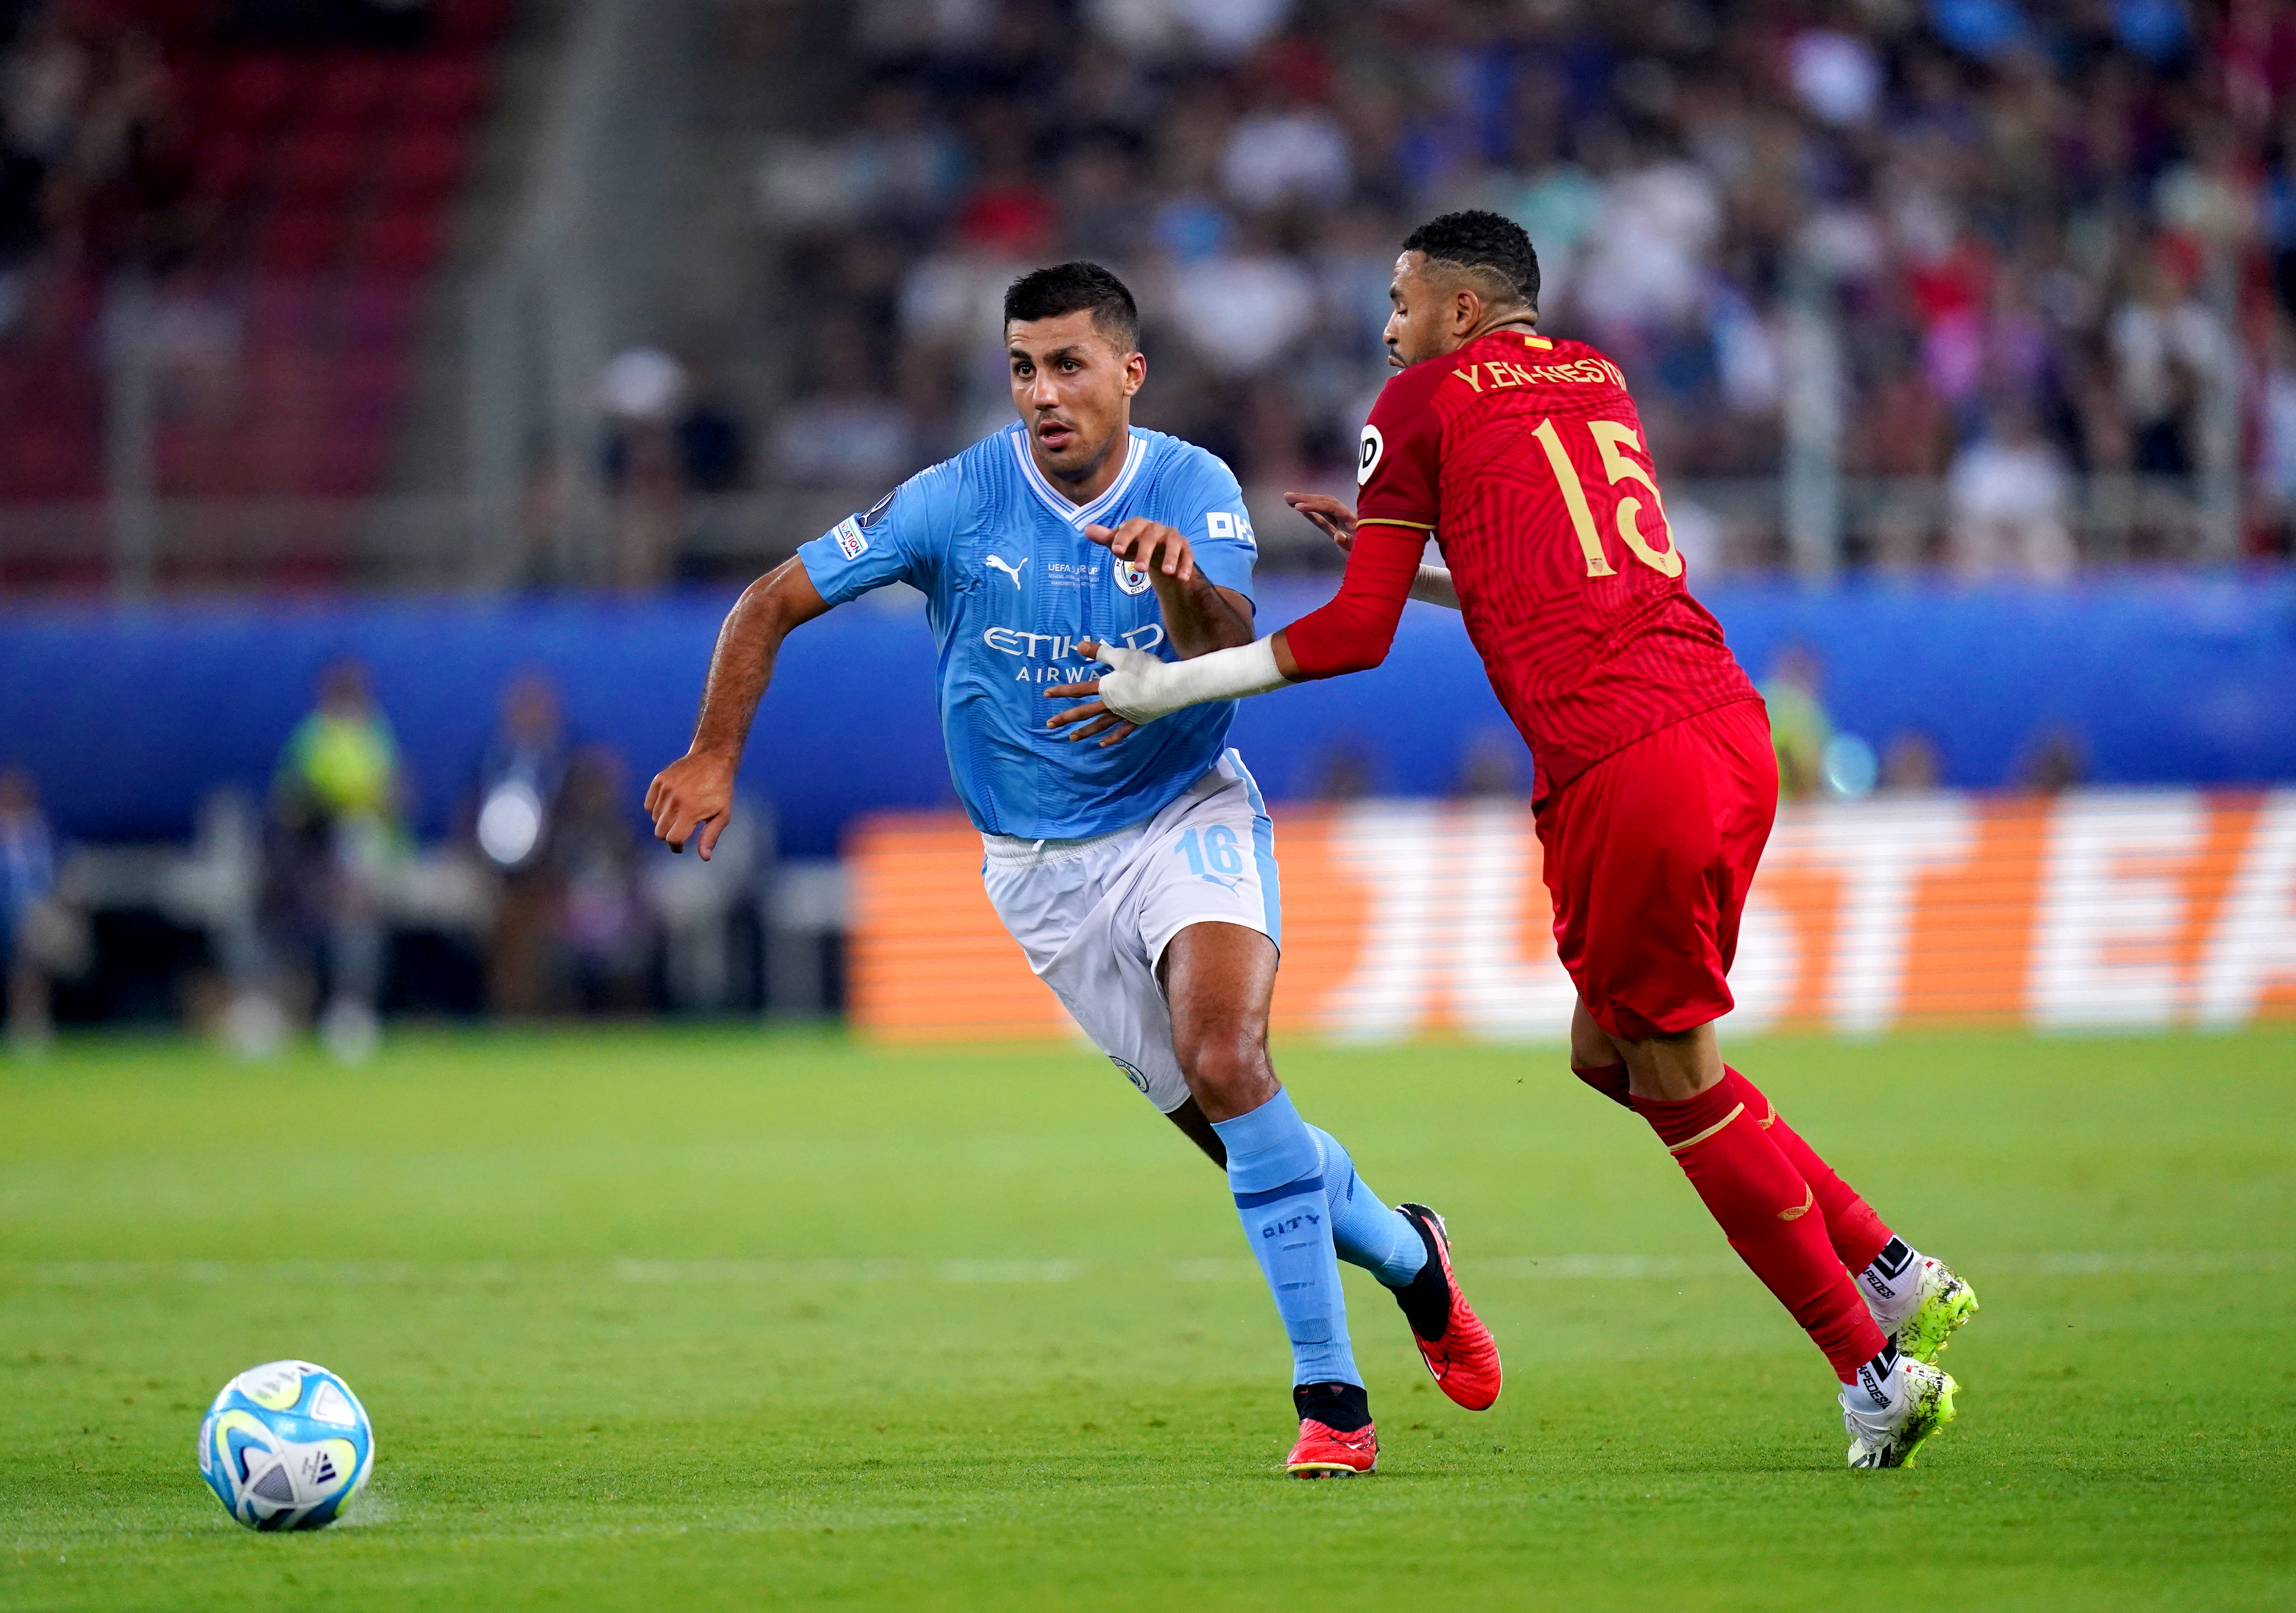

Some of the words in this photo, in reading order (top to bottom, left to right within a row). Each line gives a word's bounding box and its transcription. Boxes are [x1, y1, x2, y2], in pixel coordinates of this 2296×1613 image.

[1359, 437, 1377, 469] D
[1531, 417, 1683, 578] 15
[840, 522, 861, 554] NDATION
[1048, 563, 1070, 572] UEFA
[1088, 566, 1098, 575] UP
[1015, 666, 1115, 684] AIRWA
[1174, 824, 1243, 875] 16
